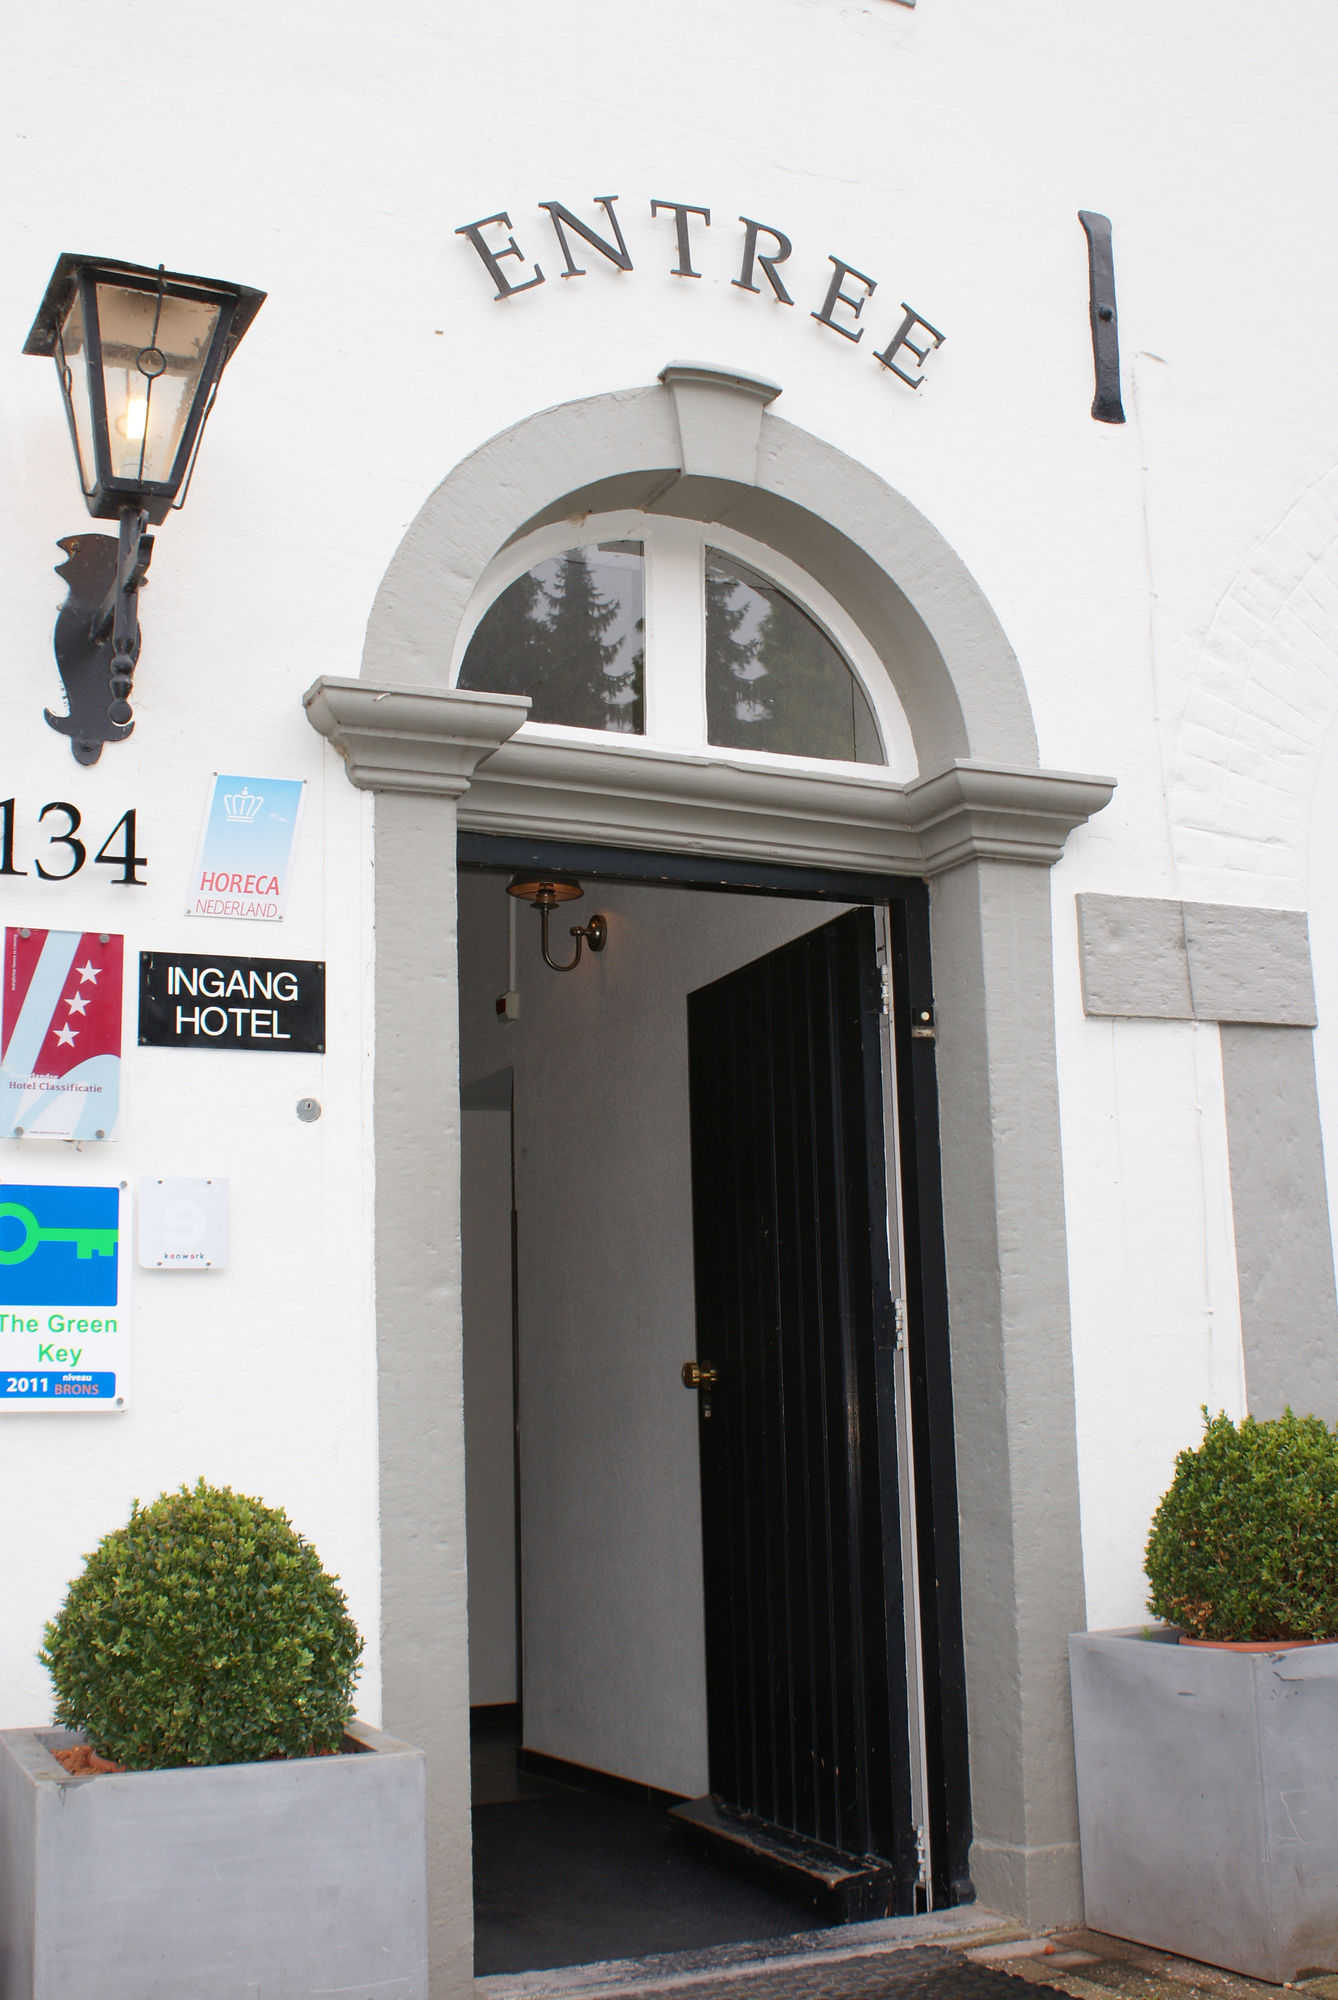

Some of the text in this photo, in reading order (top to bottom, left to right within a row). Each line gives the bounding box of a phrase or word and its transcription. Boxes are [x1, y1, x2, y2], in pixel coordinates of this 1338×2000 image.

[454, 194, 947, 390] ENTREE
[0, 797, 148, 886] 134
[200, 871, 280, 896] HORECA
[195, 898, 278, 918] NEDERLAND
[167, 965, 298, 1001] INGANG
[175, 1005, 291, 1039] HOTEL
[8, 1081, 103, 1093] Hotel Classificatie
[0, 1313, 118, 1333] The Green
[38, 1343, 82, 1367] Key
[6, 1377, 49, 1393] 2011
[62, 1373, 92, 1382] niveau
[54, 1384, 100, 1395] BRONS
